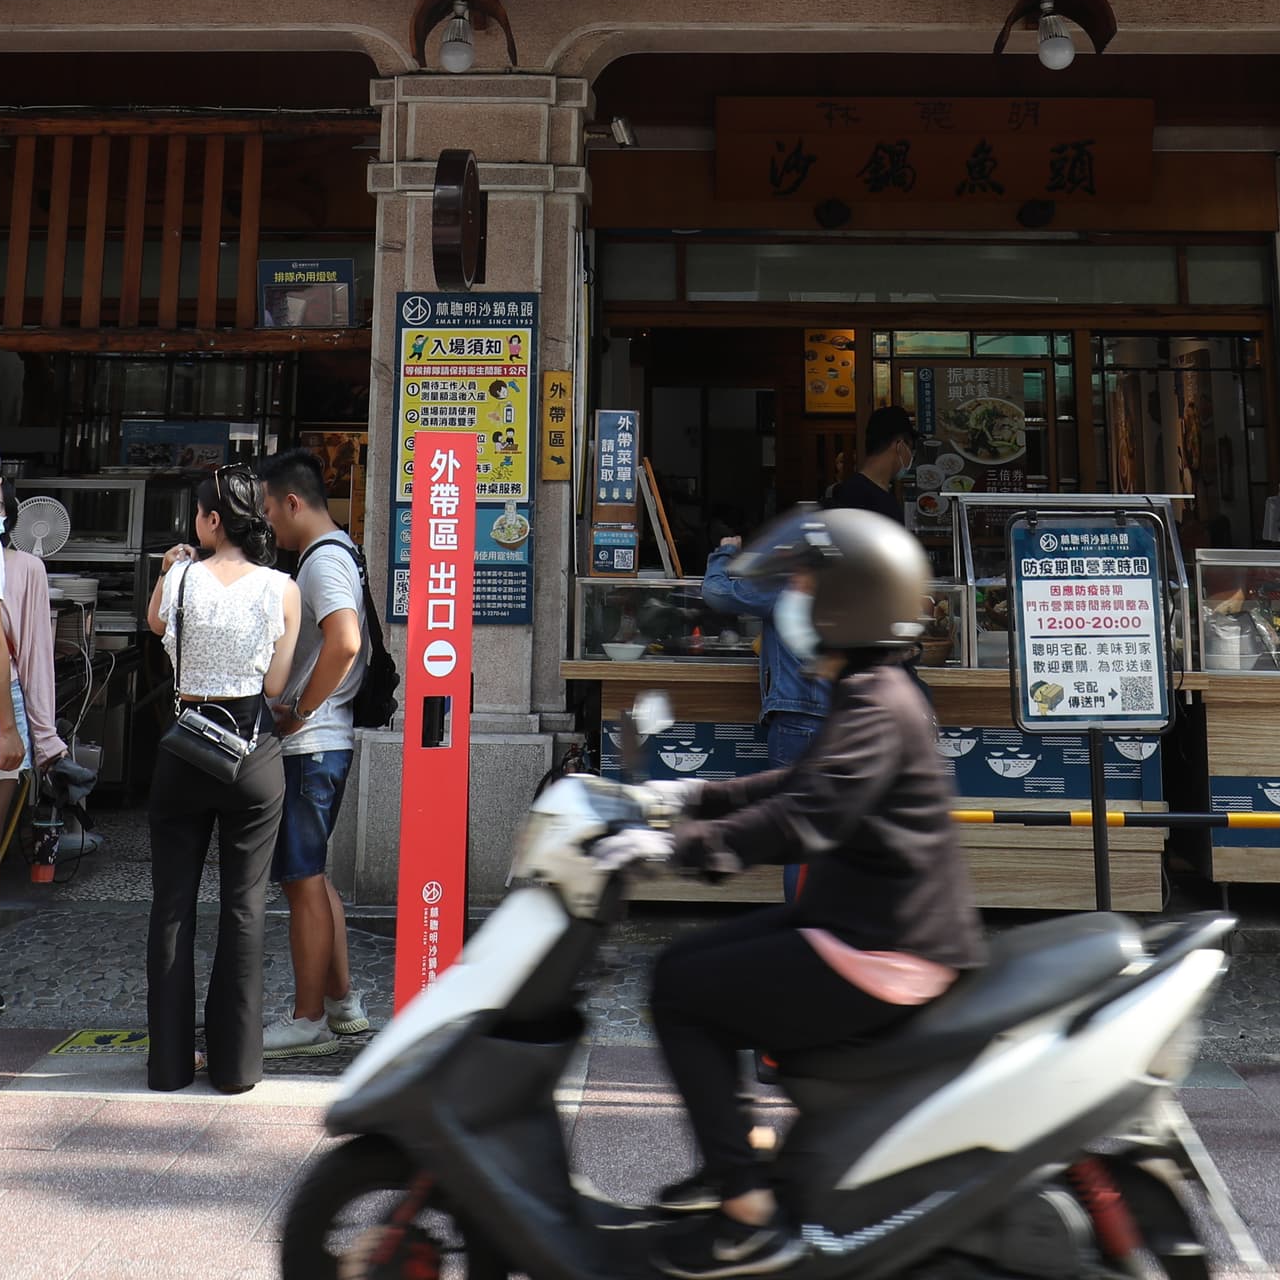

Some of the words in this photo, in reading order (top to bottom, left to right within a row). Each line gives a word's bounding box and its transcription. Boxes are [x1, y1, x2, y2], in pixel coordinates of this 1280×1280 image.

[769, 136, 1097, 197] 沙鍋魚頭
[430, 339, 502, 355] 入場須知
[548, 382, 566, 447] 外帶區
[601, 439, 614, 482] 請自取
[616, 416, 633, 482] 外帶菜單
[430, 449, 461, 550] 外帶區
[1023, 558, 1149, 575] 防疫期間營業時間
[427, 561, 456, 630] 出口
[1026, 600, 1150, 612] 門市營業時間將調整為
[1050, 585, 1123, 597] 因應防疫時期
[1068, 696, 1105, 708] 傳送門
[1073, 681, 1098, 693] 宅配
